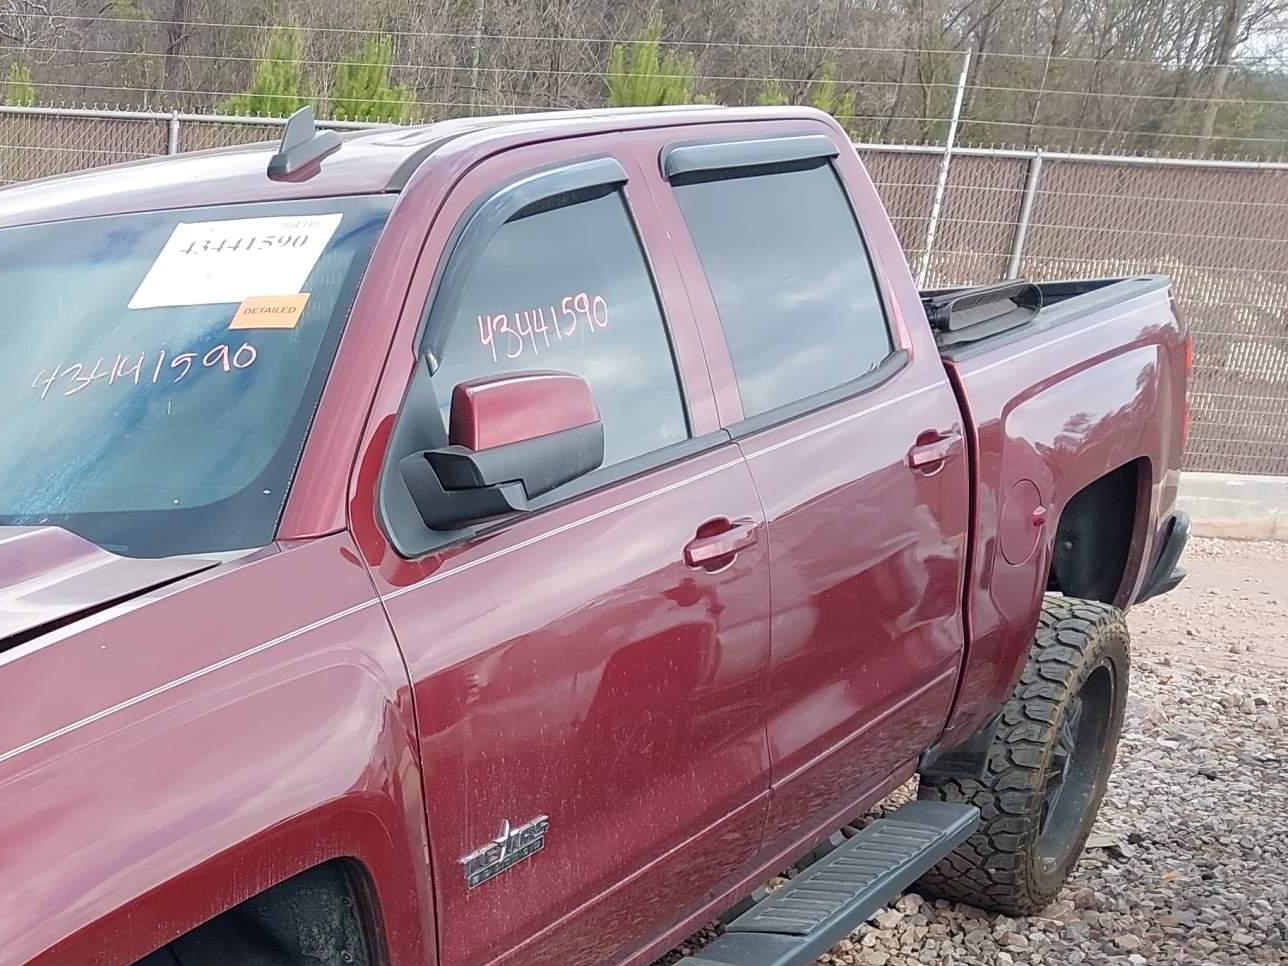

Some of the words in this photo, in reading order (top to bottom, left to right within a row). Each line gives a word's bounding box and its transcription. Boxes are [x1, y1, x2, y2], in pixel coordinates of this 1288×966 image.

[179, 234, 309, 256] 43441590
[243, 306, 297, 315] DETAILED
[477, 291, 608, 363] 43441590
[31, 341, 258, 400] 43441590
